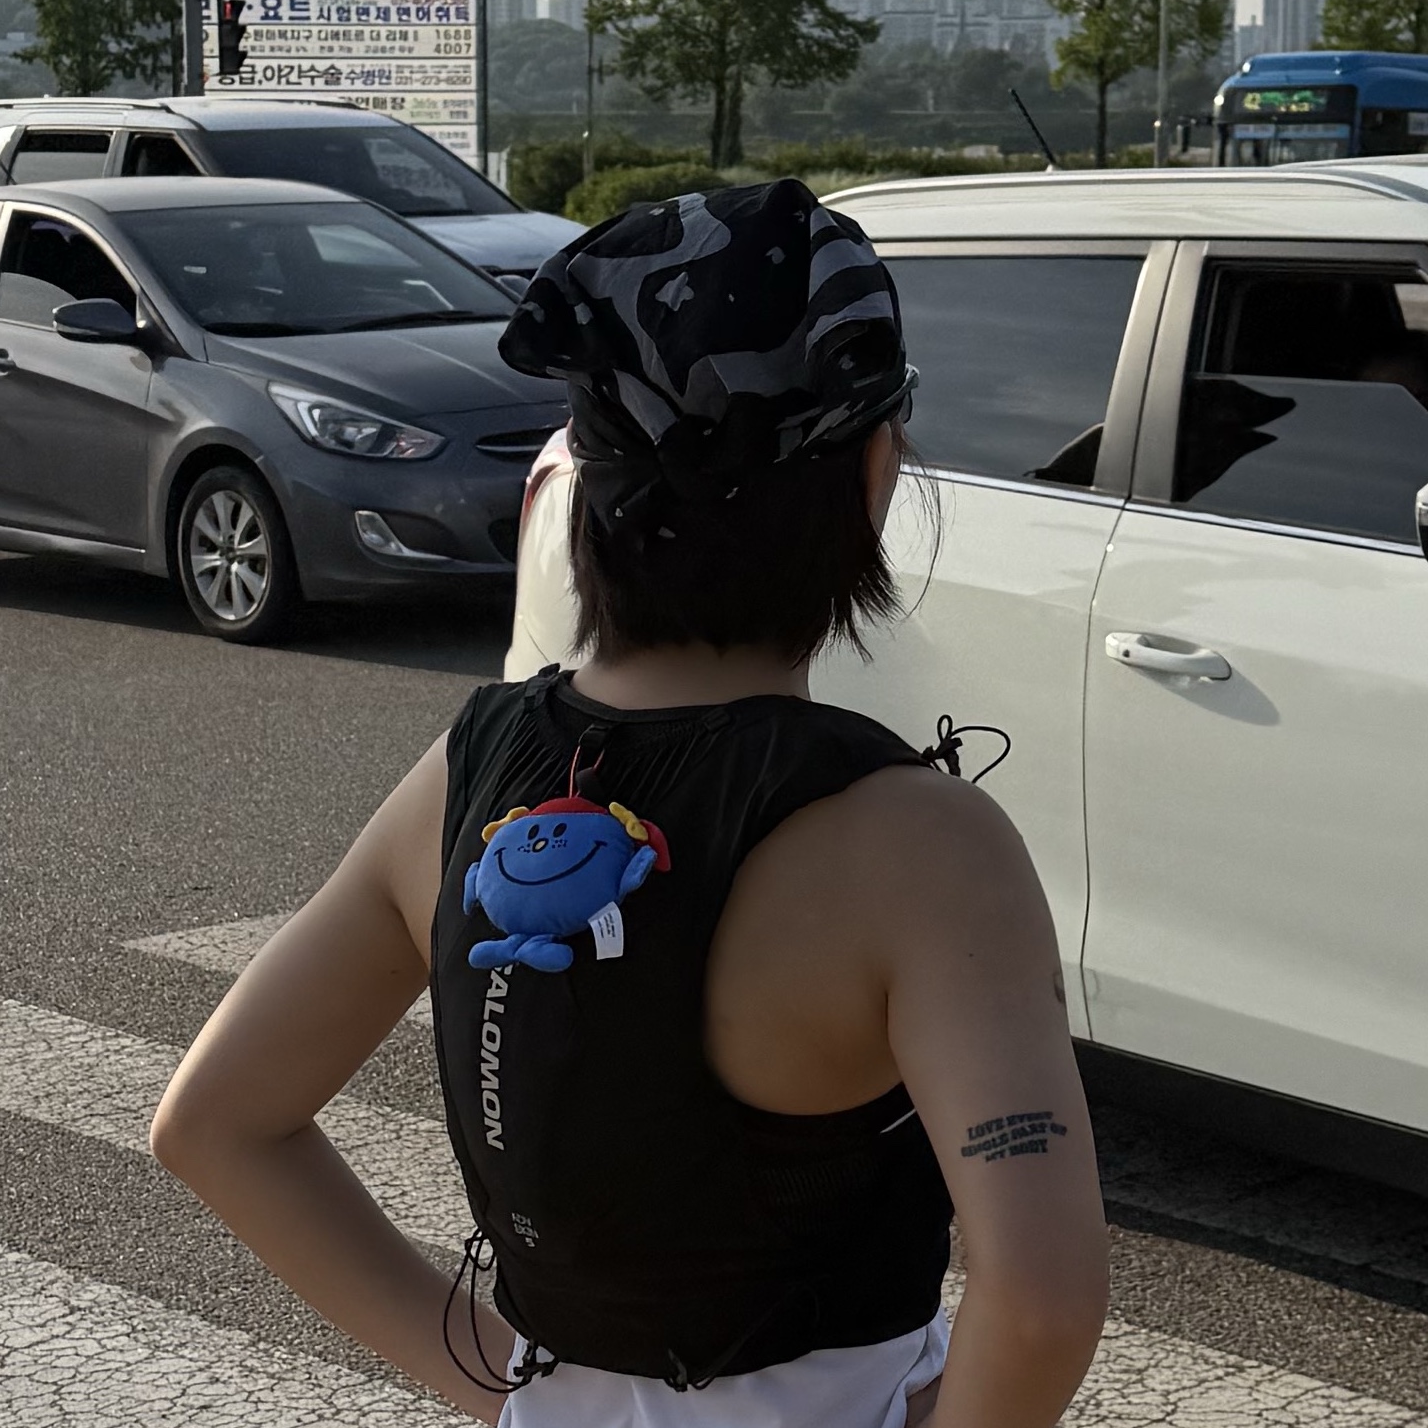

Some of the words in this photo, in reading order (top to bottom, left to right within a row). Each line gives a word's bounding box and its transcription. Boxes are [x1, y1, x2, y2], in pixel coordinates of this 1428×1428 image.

[435, 29, 472, 41] 1688
[434, 42, 472, 54] 4007
[968, 1118, 1004, 1140] LOVE
